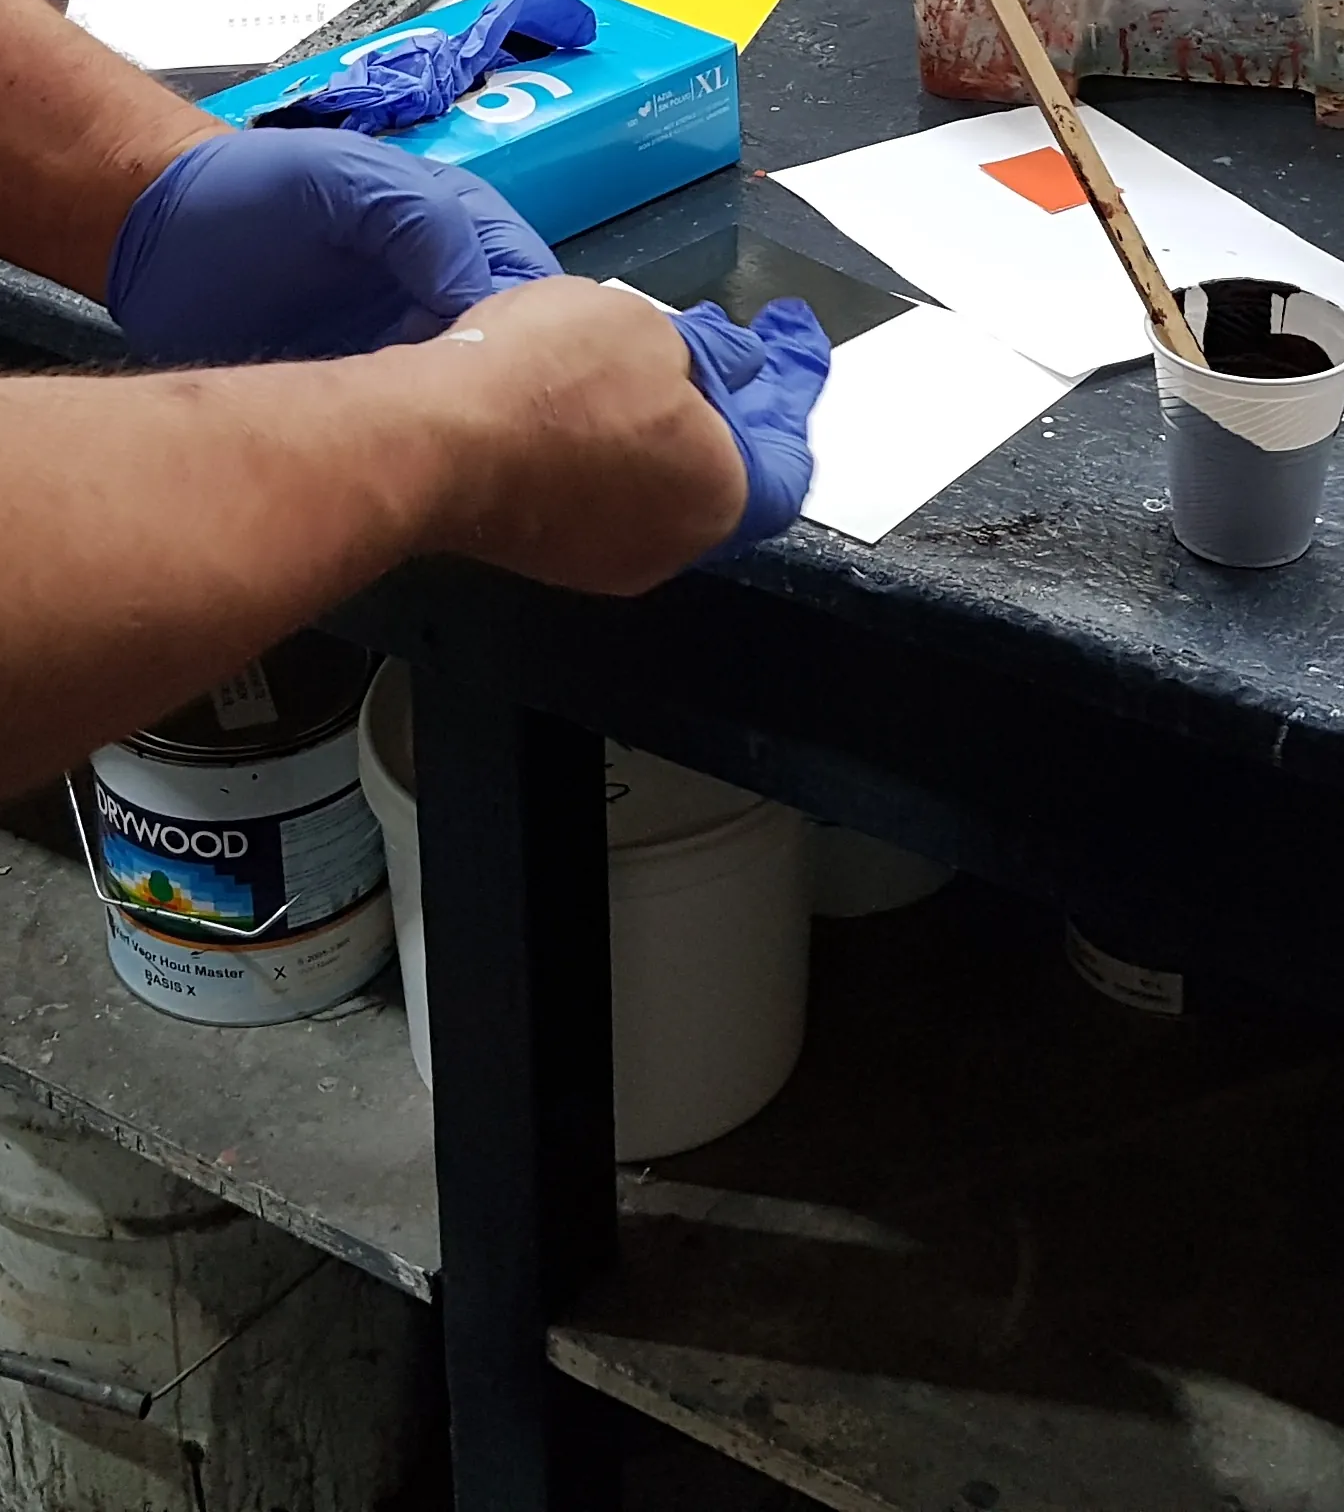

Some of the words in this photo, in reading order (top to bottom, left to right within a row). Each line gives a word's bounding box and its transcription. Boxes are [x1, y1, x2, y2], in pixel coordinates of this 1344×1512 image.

[696, 65, 730, 98] XL
[95, 783, 249, 860] DRYWOOD
[160, 955, 192, 975] Hout
[195, 964, 246, 980] Master
[144, 969, 183, 994] BASIS
[186, 984, 197, 997] X
